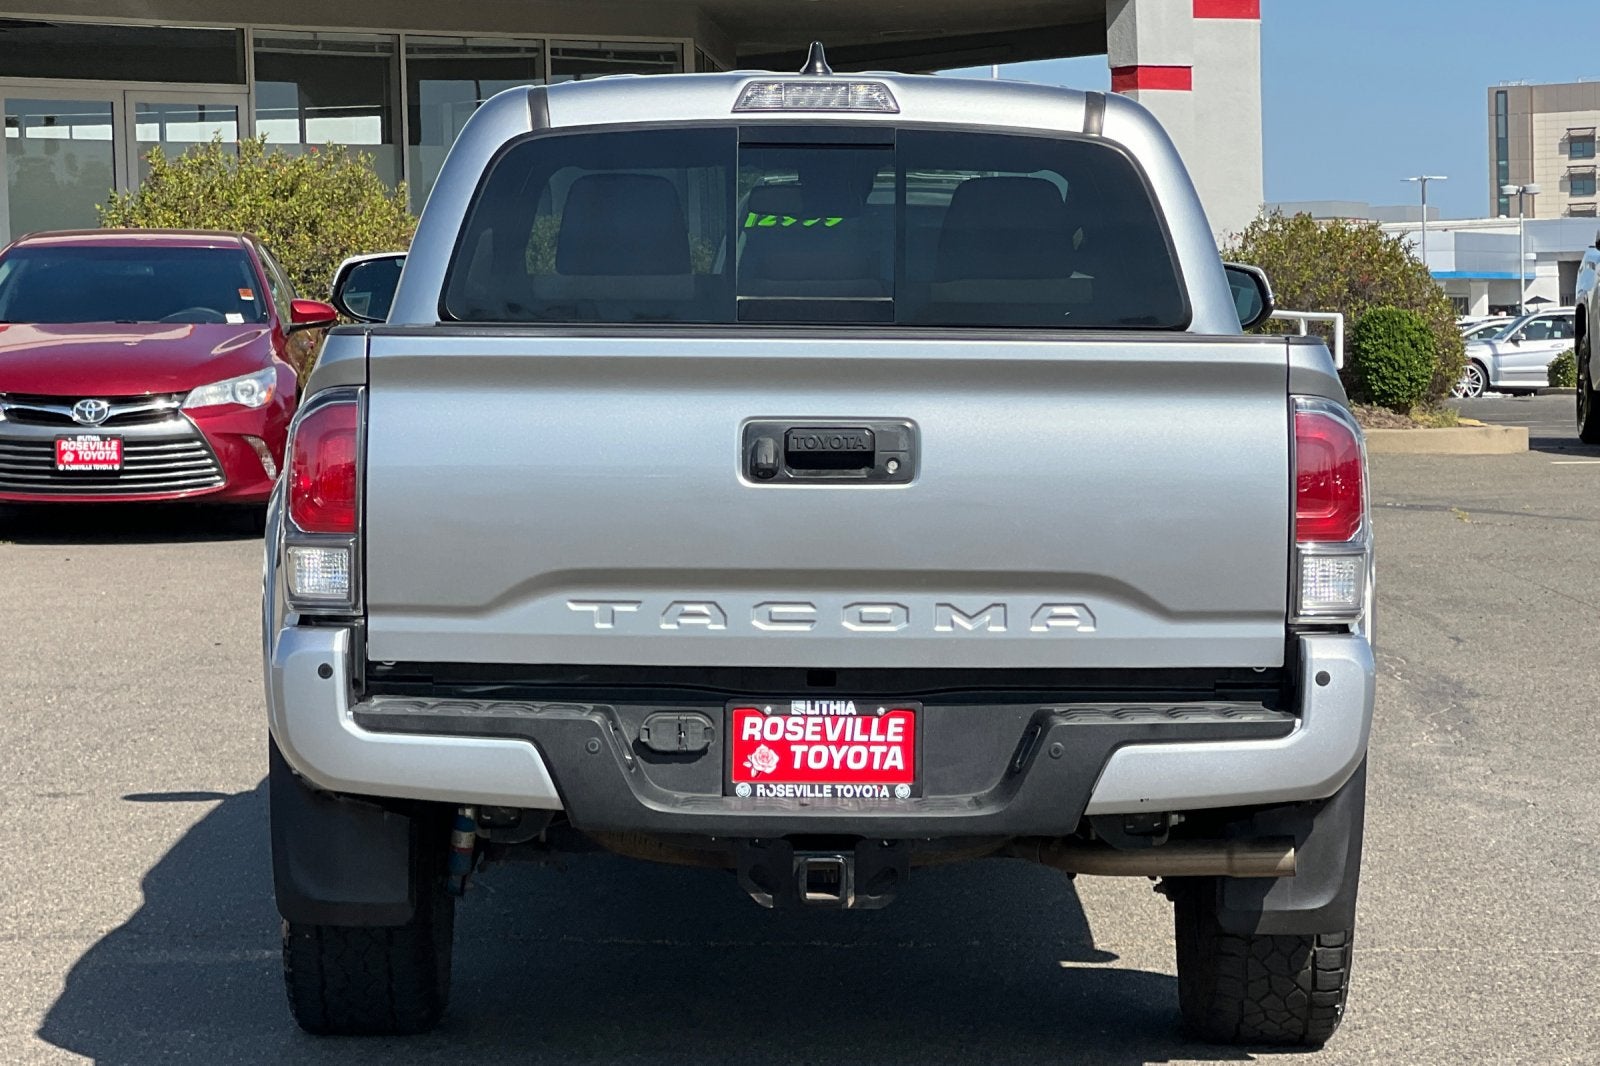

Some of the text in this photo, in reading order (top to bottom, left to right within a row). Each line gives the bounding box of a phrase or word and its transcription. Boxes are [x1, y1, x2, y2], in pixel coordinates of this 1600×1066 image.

[60, 441, 119, 451] ROSEVILLE
[793, 435, 867, 450] TOYOTA
[78, 451, 118, 460] TOYOTA
[566, 600, 1097, 632] TACOMA
[806, 700, 857, 715] LITHIA
[742, 716, 905, 742] ROSEVILLE
[791, 745, 904, 770] TOYOTA
[757, 784, 889, 798] ROSEVILLE TOYOTA
